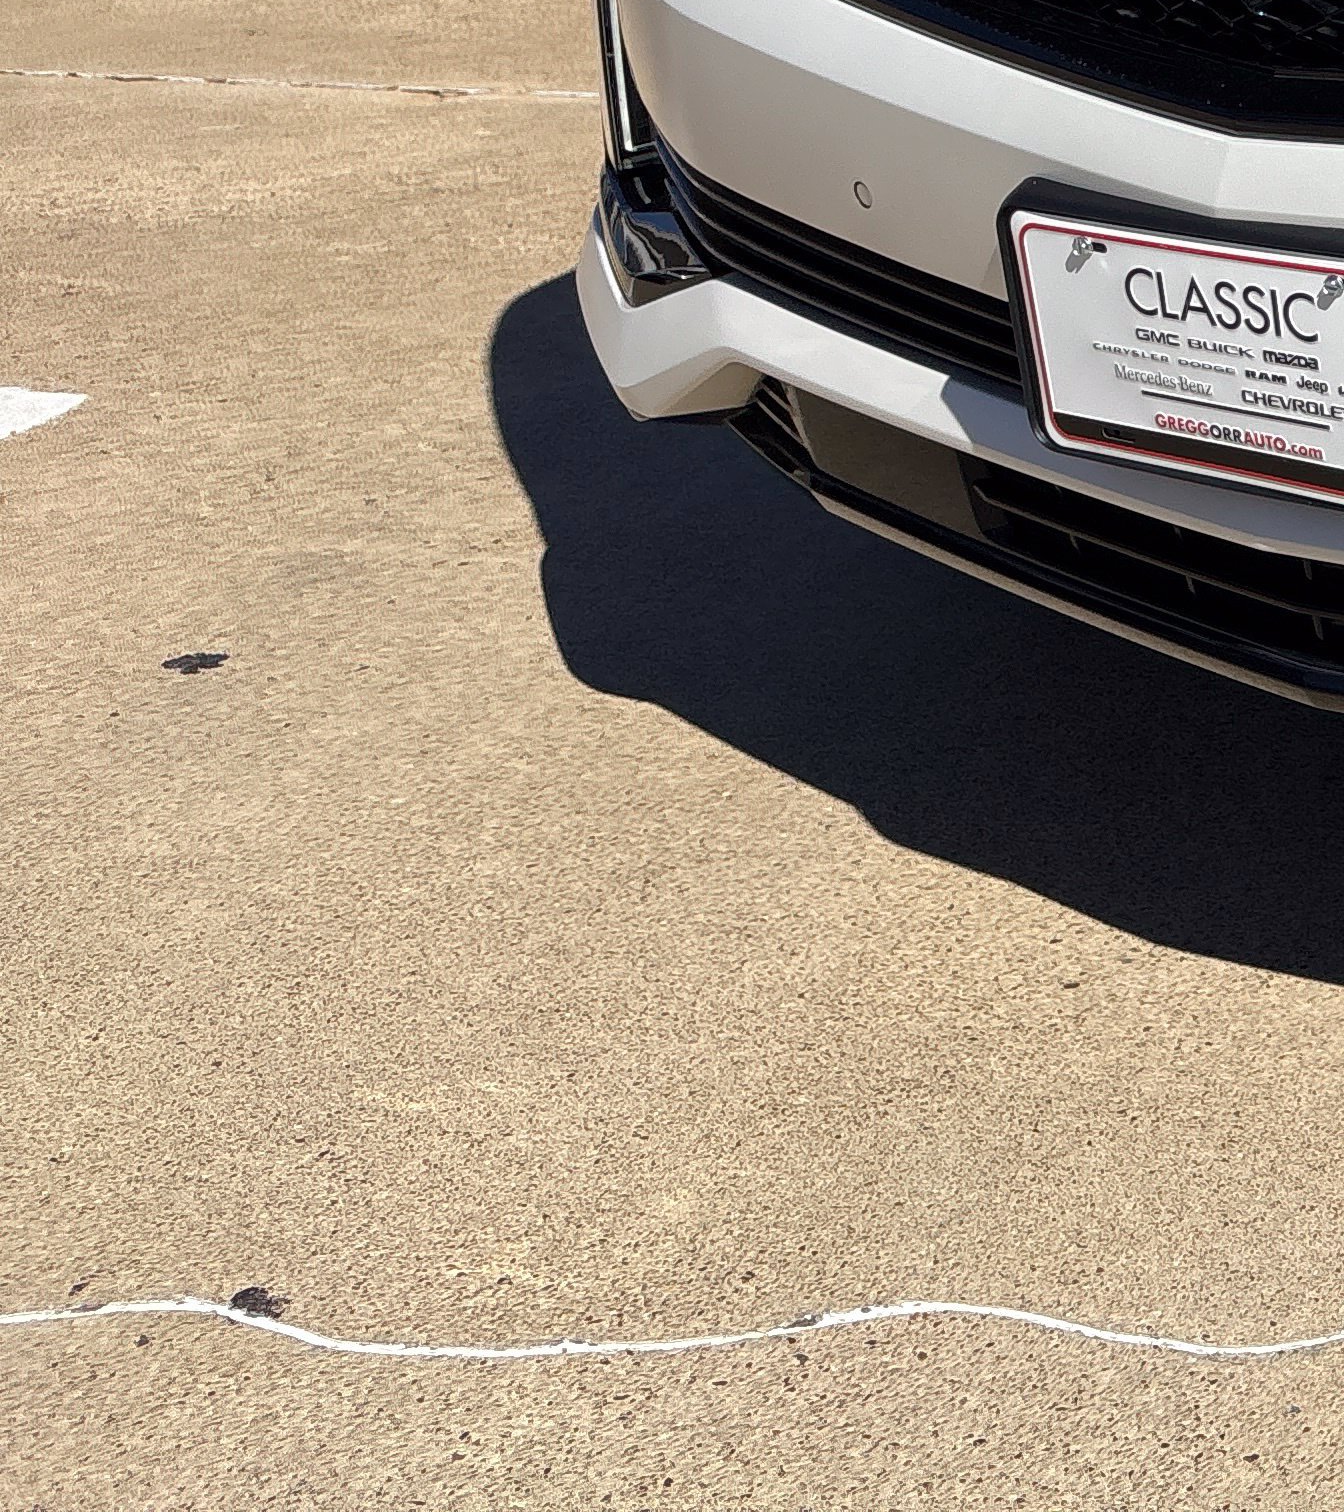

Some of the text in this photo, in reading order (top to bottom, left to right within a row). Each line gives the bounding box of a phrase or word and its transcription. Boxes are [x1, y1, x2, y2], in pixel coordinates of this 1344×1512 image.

[1124, 267, 1319, 342] CLASSIC
[1135, 327, 1181, 347] GMC
[1187, 338, 1256, 358] BUICK
[1093, 342, 1169, 363] CHRYSLER
[1177, 358, 1237, 375] DODGE
[1244, 369, 1287, 384] RAM
[1296, 375, 1329, 394] Jeep
[1114, 363, 1213, 396] Mercedes-Benz
[1154, 413, 1324, 460] GREGGORRAUTO.com
